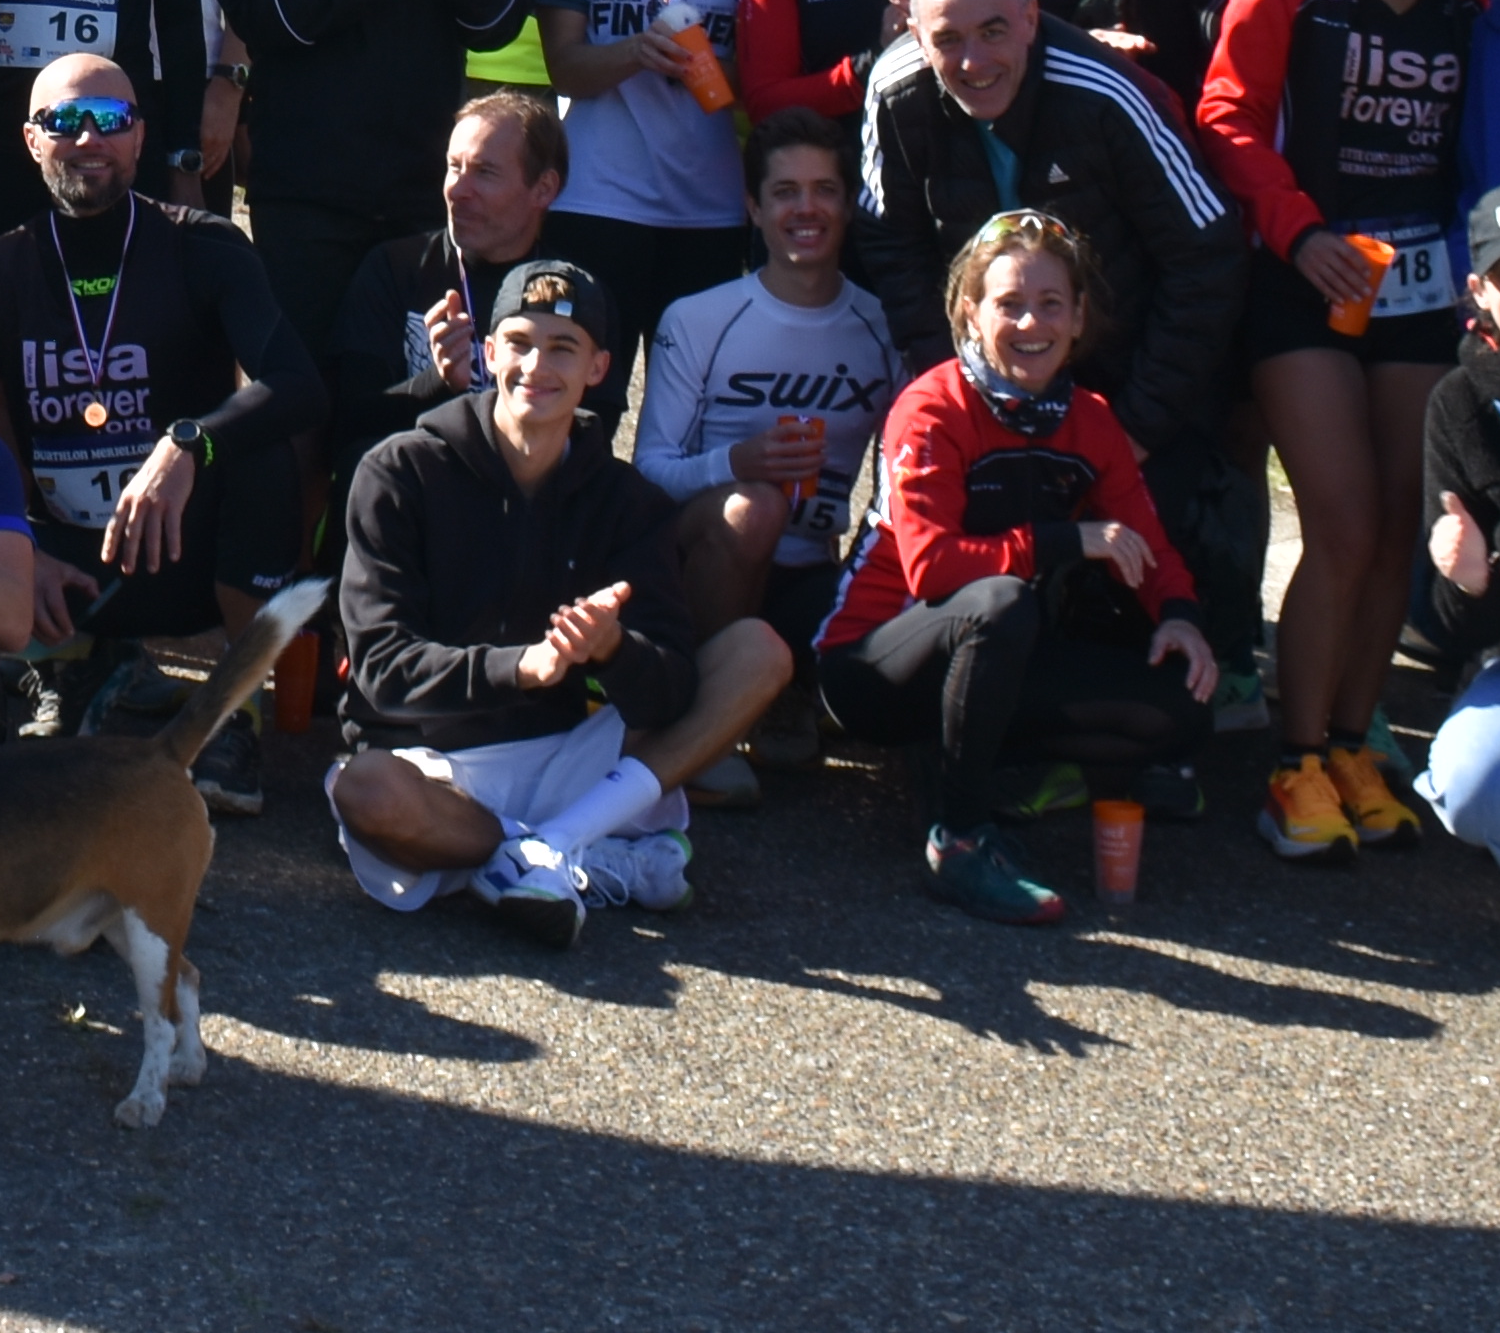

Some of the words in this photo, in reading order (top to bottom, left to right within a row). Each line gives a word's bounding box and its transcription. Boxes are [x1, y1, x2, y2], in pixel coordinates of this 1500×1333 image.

[48, 10, 100, 45] 16
[1342, 31, 1461, 94] lisa
[1391, 249, 1432, 287] 18
[22, 339, 149, 389] lisa
